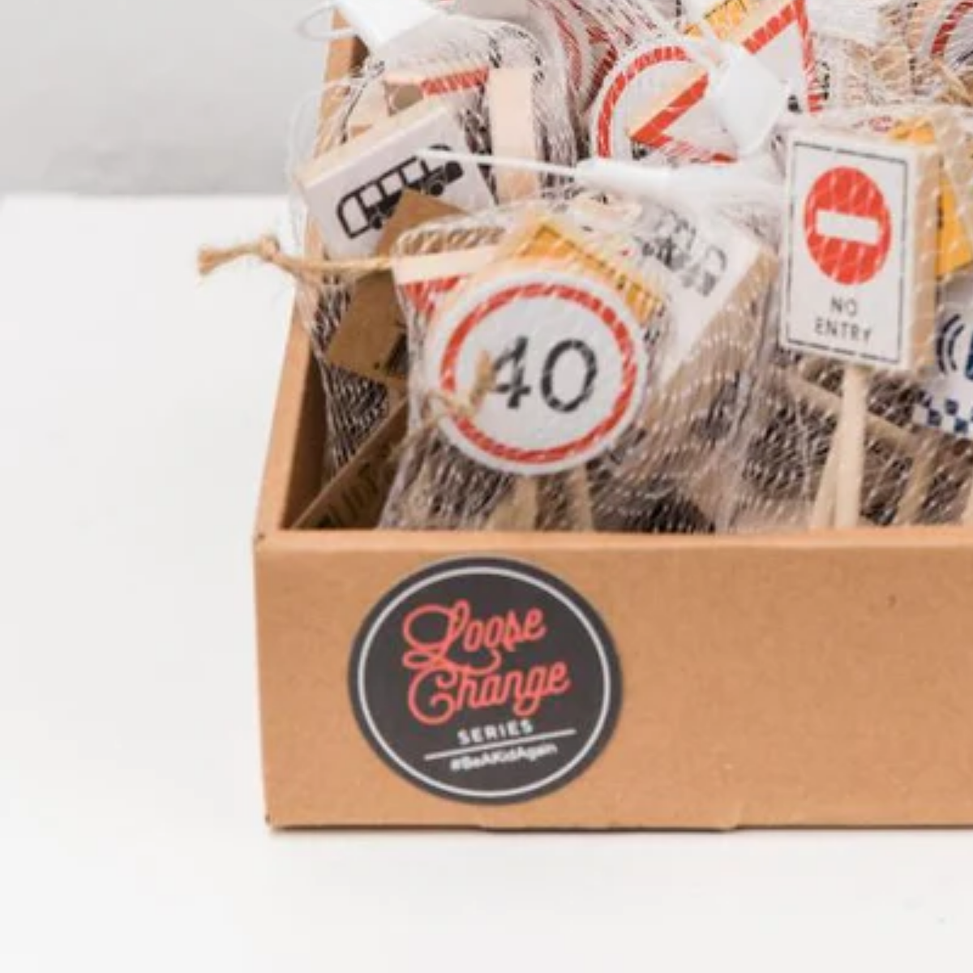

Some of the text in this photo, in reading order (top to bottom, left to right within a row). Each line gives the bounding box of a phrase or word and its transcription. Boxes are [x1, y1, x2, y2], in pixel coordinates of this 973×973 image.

[814, 315, 873, 345] ENTRY
[829, 295, 858, 318] NO
[490, 336, 598, 413] 40
[402, 599, 546, 672] Loose
[407, 661, 570, 725] Change
[456, 718, 534, 746] SERIES
